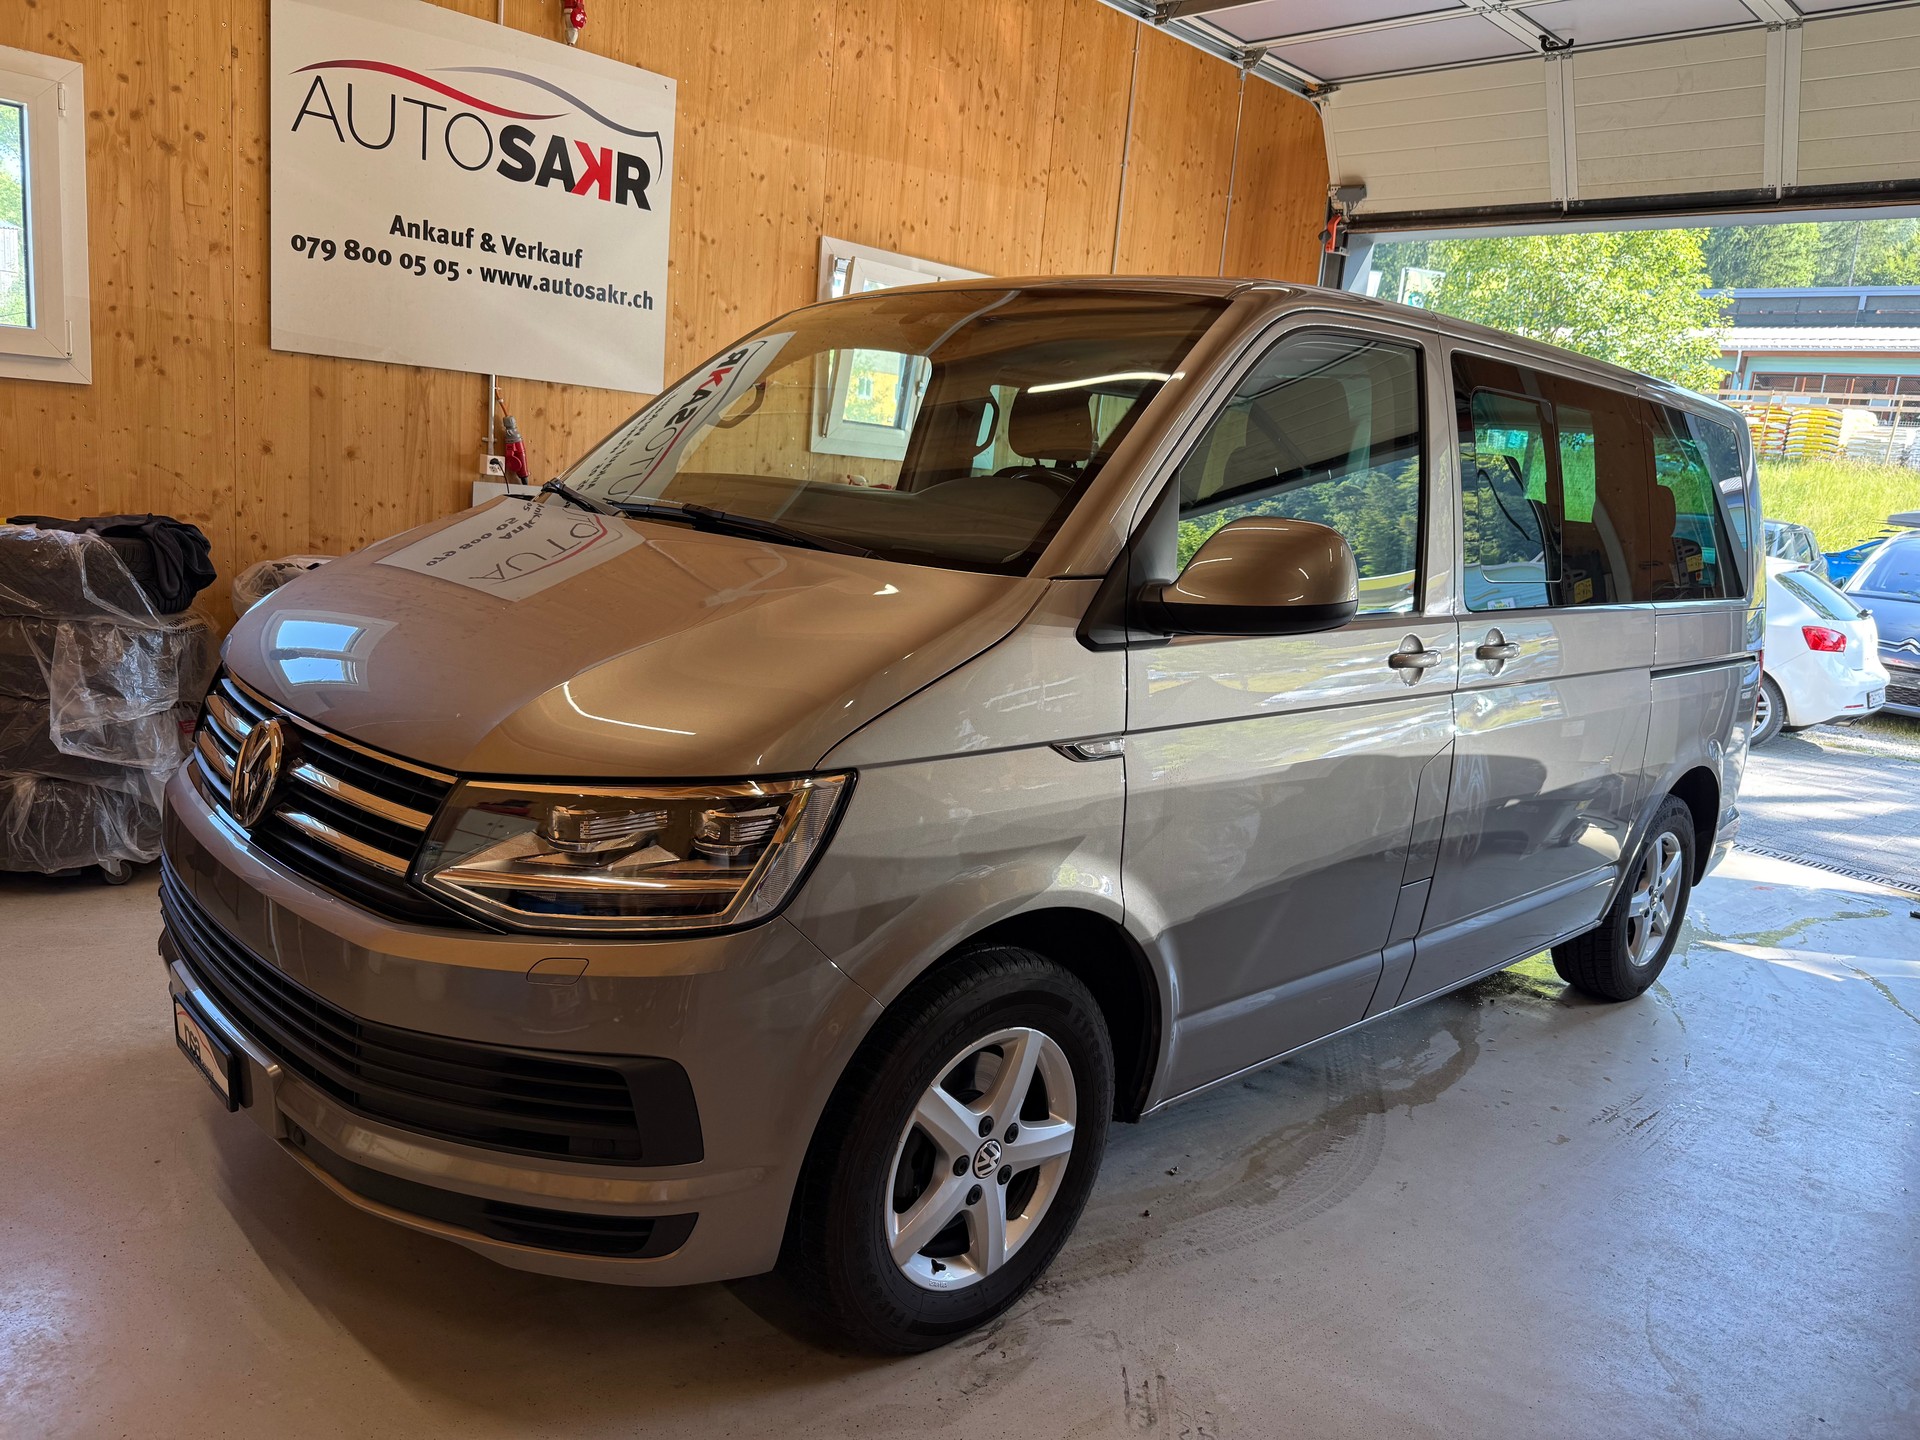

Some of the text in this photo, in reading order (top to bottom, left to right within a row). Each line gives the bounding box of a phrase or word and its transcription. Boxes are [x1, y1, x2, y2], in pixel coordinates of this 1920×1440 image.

[291, 75, 652, 211] AUTOSAKR
[291, 234, 653, 310] 079 800 05 05 www.autosakr.ch
[389, 214, 583, 269] Ankauf & Verkauf
